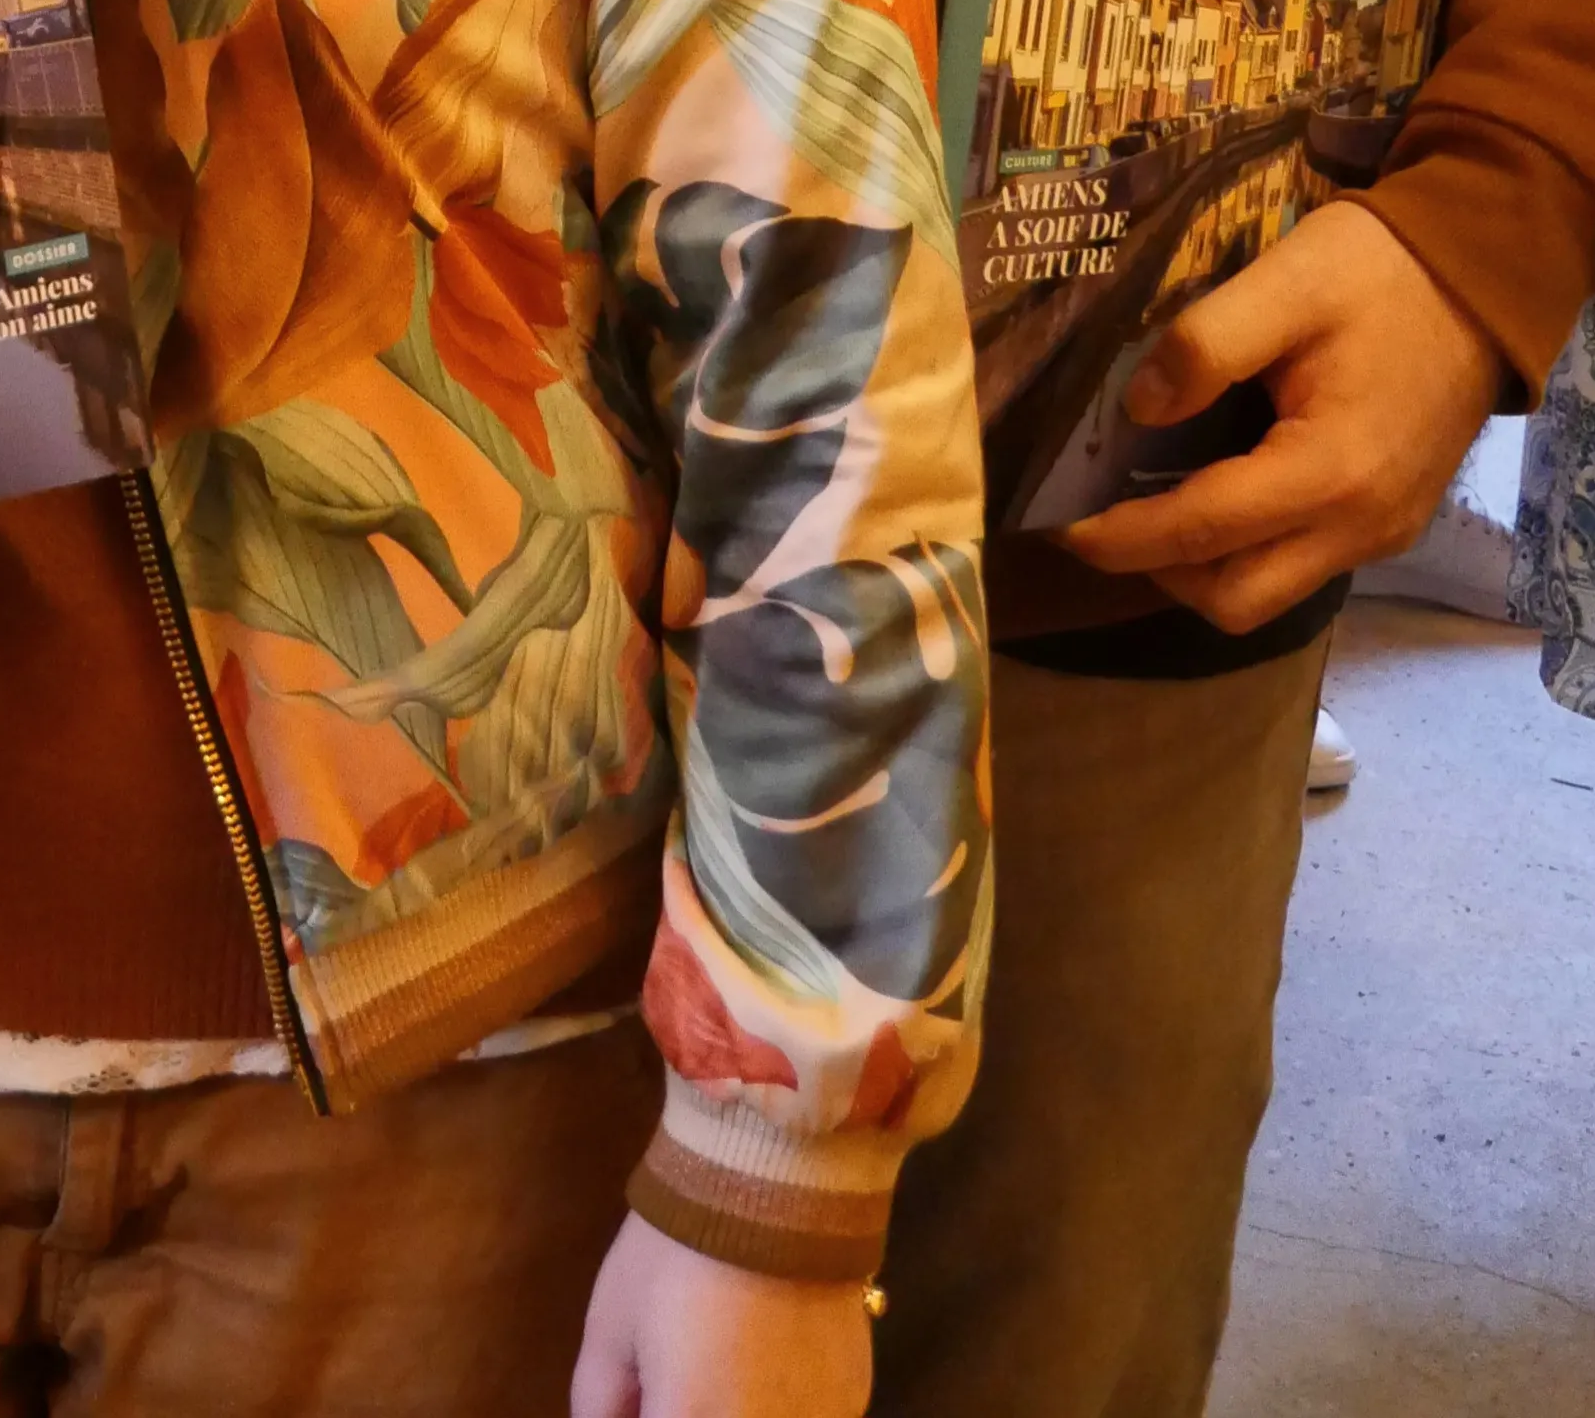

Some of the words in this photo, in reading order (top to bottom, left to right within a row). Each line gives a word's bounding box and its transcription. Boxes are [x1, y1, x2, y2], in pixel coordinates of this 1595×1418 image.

[1005, 154, 1052, 169] CULTURE
[992, 177, 1109, 213] AMIENS
[987, 220, 1008, 249] A
[1015, 214, 1084, 248] SOIF
[1089, 211, 1130, 241] DE
[983, 246, 1117, 285] CULTURE
[32, 300, 97, 333] aime
